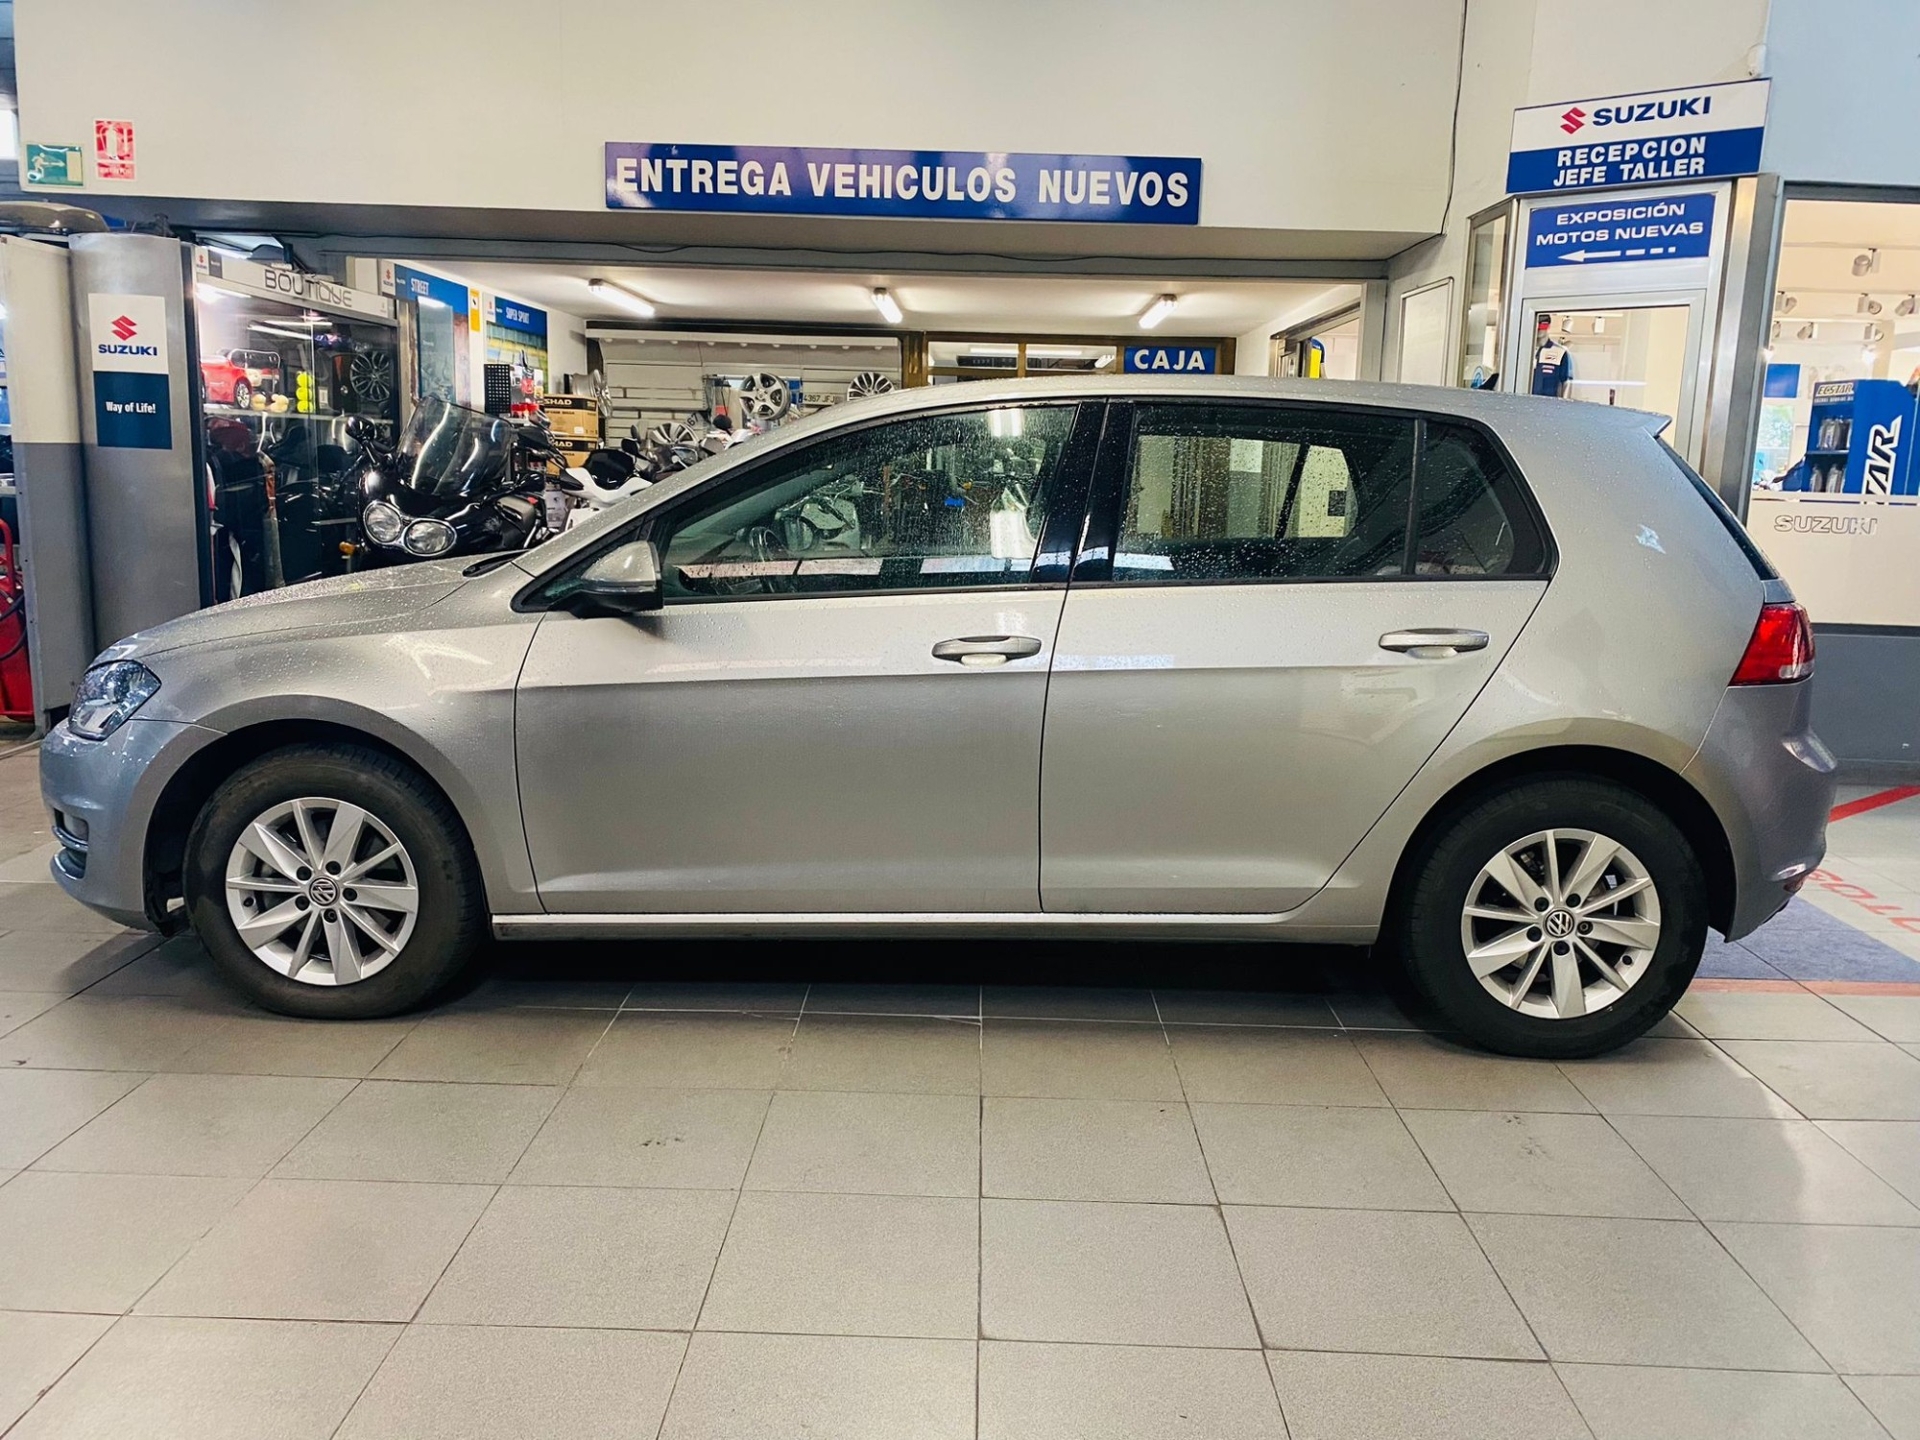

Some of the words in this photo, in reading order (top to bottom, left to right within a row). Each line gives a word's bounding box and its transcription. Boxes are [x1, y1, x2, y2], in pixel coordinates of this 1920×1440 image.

[1592, 96, 1712, 127] SUZUKI
[1557, 136, 1707, 168] RECEPCION
[615, 157, 792, 196] ENTREGA
[807, 162, 1017, 203] VEHICULOS
[1038, 169, 1189, 207] NUEVOS
[1553, 165, 1607, 188] JEFE
[1619, 157, 1706, 181] TALLER
[1556, 202, 1686, 226] EXPOSICIÓN
[1536, 229, 1609, 246] MOTOS
[1615, 222, 1704, 241] NUEVAS
[264, 268, 353, 308] BOUTIQUE
[411, 277, 429, 296] STREET
[98, 344, 157, 357] SUZUKI
[1133, 348, 1206, 371] CAJA
[105, 401, 122, 413] Way
[124, 402, 133, 413] of
[135, 401, 156, 414] Life!
